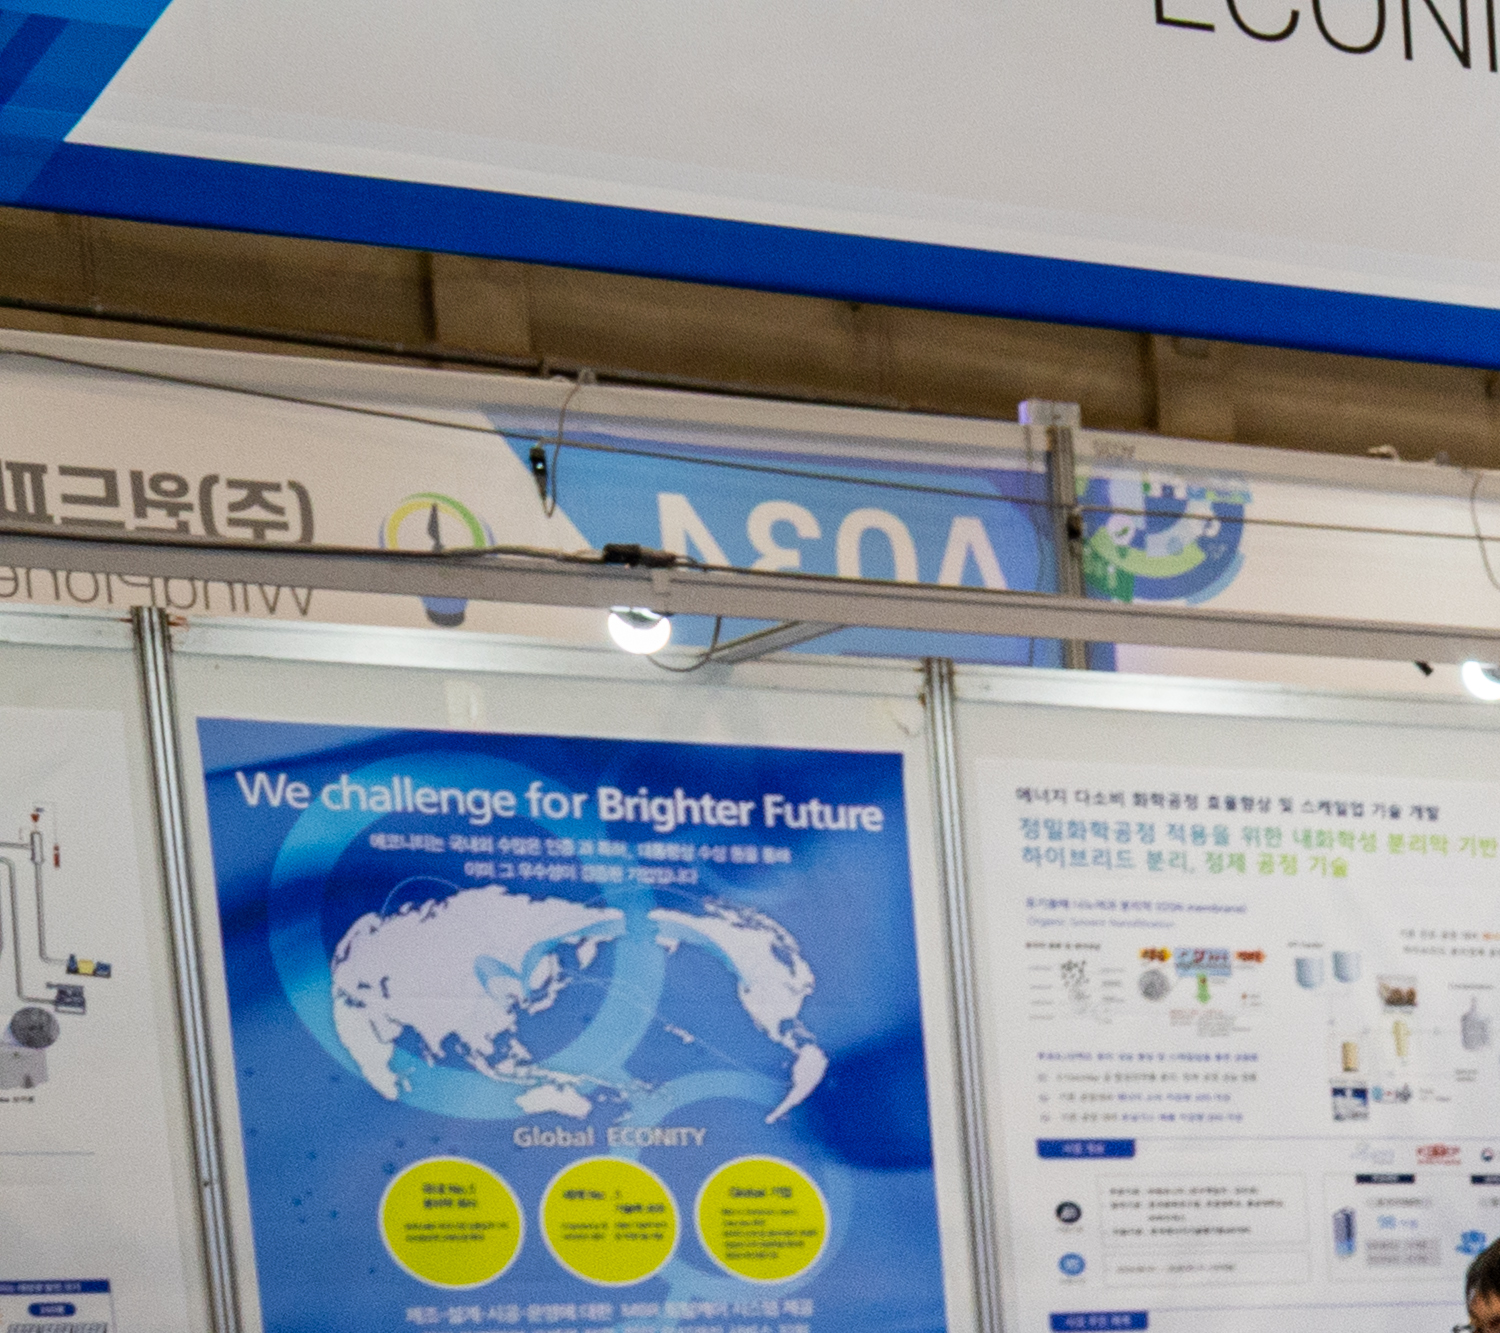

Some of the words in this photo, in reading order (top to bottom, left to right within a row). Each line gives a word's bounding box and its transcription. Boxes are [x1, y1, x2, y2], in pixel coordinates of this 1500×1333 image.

[236, 770, 309, 807] We
[321, 776, 516, 824] challenge
[525, 782, 588, 820] for
[598, 786, 753, 833] Brighter
[763, 795, 884, 833] Future
[1015, 787, 1067, 805] 에너지
[1074, 789, 1125, 808] 다소비
[1133, 790, 1199, 811] 화학공정
[1371, 801, 1401, 820] 기술
[1019, 815, 1157, 845] 정밀화학공정
[1167, 821, 1231, 848] 적용을
[1241, 824, 1283, 848] 위한
[1387, 831, 1450, 858] 분리막
[1458, 833, 1498, 860] 기반
[1021, 846, 1136, 872] 하이브리드
[1205, 851, 1247, 874] 정제
[1256, 853, 1299, 876] 공정
[1309, 854, 1349, 878] 기술
[513, 1125, 594, 1147] Global
[607, 1126, 707, 1147] ECONITY
